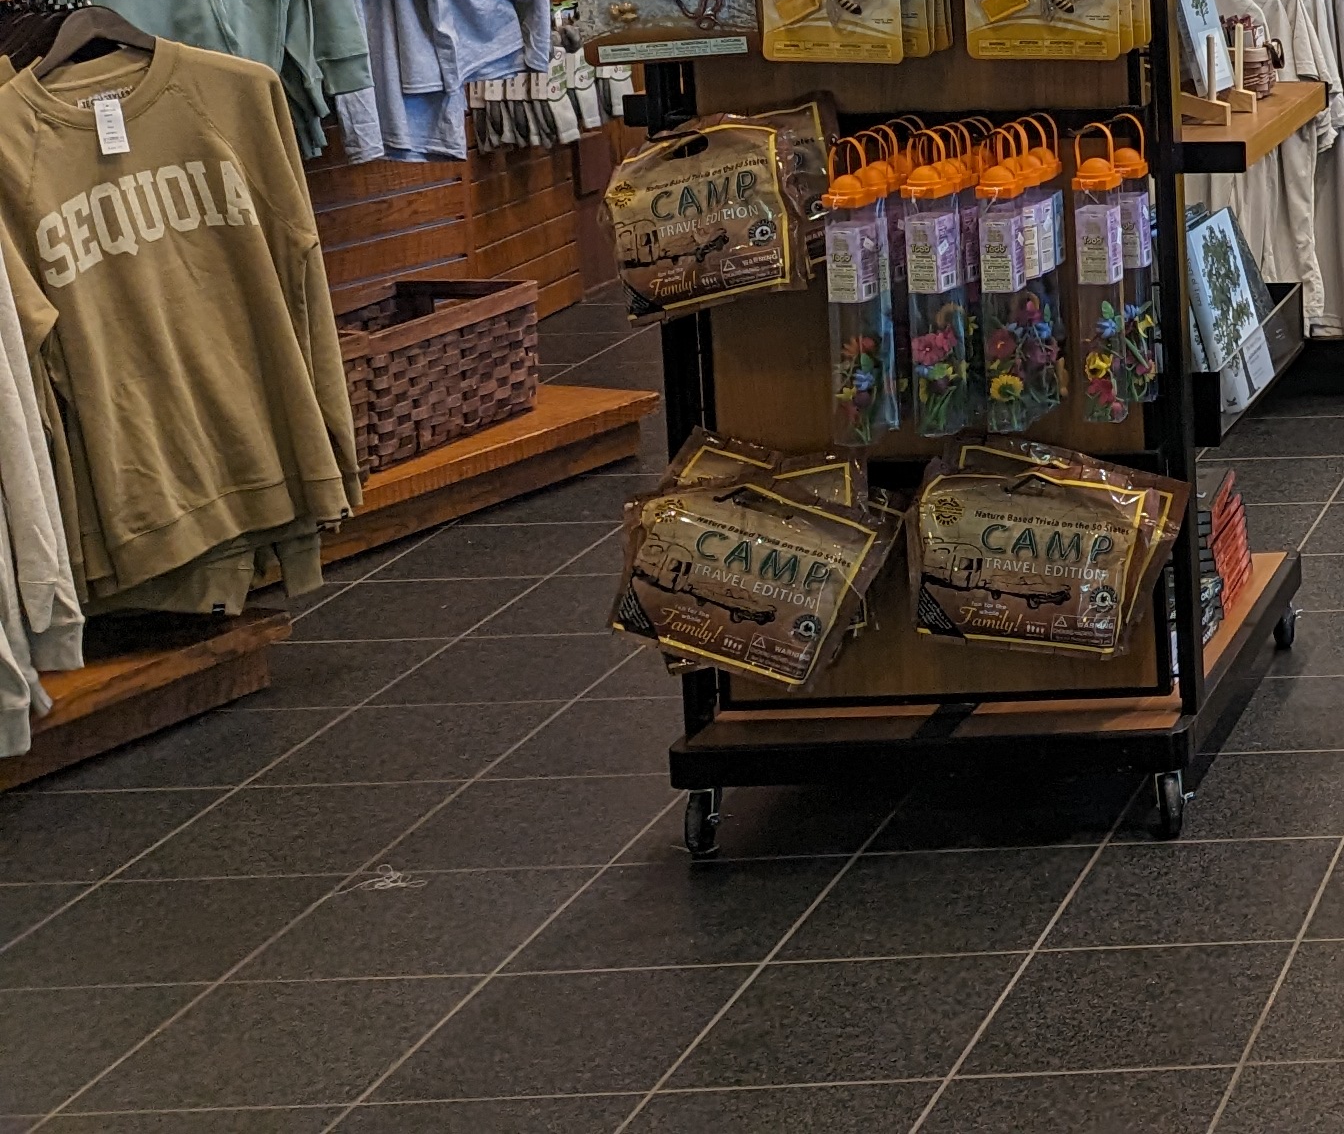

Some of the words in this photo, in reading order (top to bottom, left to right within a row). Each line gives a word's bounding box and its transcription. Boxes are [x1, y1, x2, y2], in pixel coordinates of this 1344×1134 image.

[743, 157, 769, 169] States
[650, 169, 756, 220] CAMP
[35, 160, 260, 290] SEQUOIA
[658, 219, 702, 239] TRAVEL
[705, 204, 760, 226] EDITION
[650, 268, 698, 300] Family!
[696, 515, 726, 531] Nature
[726, 523, 755, 538] Based
[794, 544, 811, 556] the
[974, 509, 1006, 522] Nature
[1007, 512, 1034, 524] Based
[1035, 516, 1060, 528] Trivia
[1074, 519, 1090, 531] the
[1103, 524, 1131, 536] States
[694, 529, 831, 592] CAMP
[980, 523, 1114, 564] CAMP
[692, 562, 748, 591] TRAVEL
[752, 580, 819, 610] EDITION
[984, 556, 1038, 575] TRAVEL
[1044, 564, 1108, 581] EDITION
[655, 606, 723, 646] Family!
[956, 605, 1023, 636] Family!
